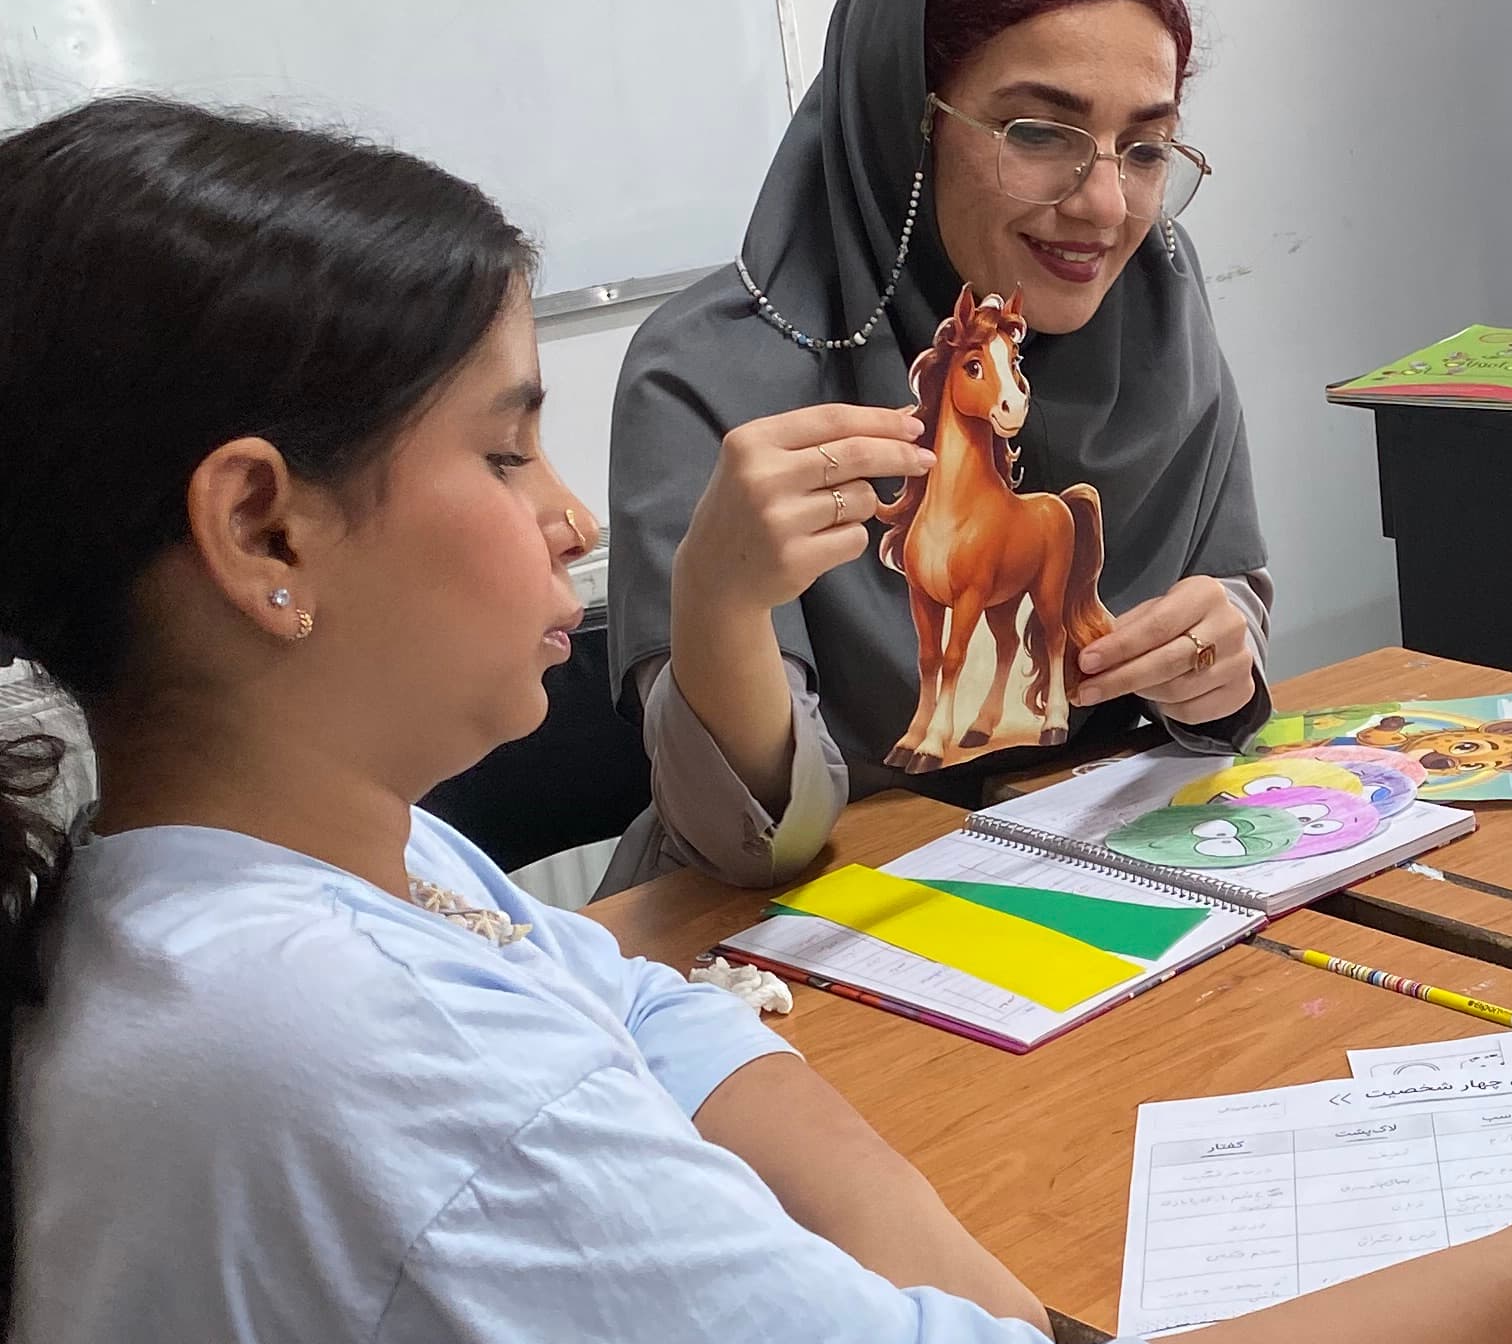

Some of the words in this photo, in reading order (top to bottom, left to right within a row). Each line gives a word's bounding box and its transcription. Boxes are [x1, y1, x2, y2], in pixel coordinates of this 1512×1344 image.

[1365, 1082, 1453, 1098] شخصیت
[1461, 1079, 1502, 1092] چهار
[1207, 1140, 1245, 1153] کفتار
